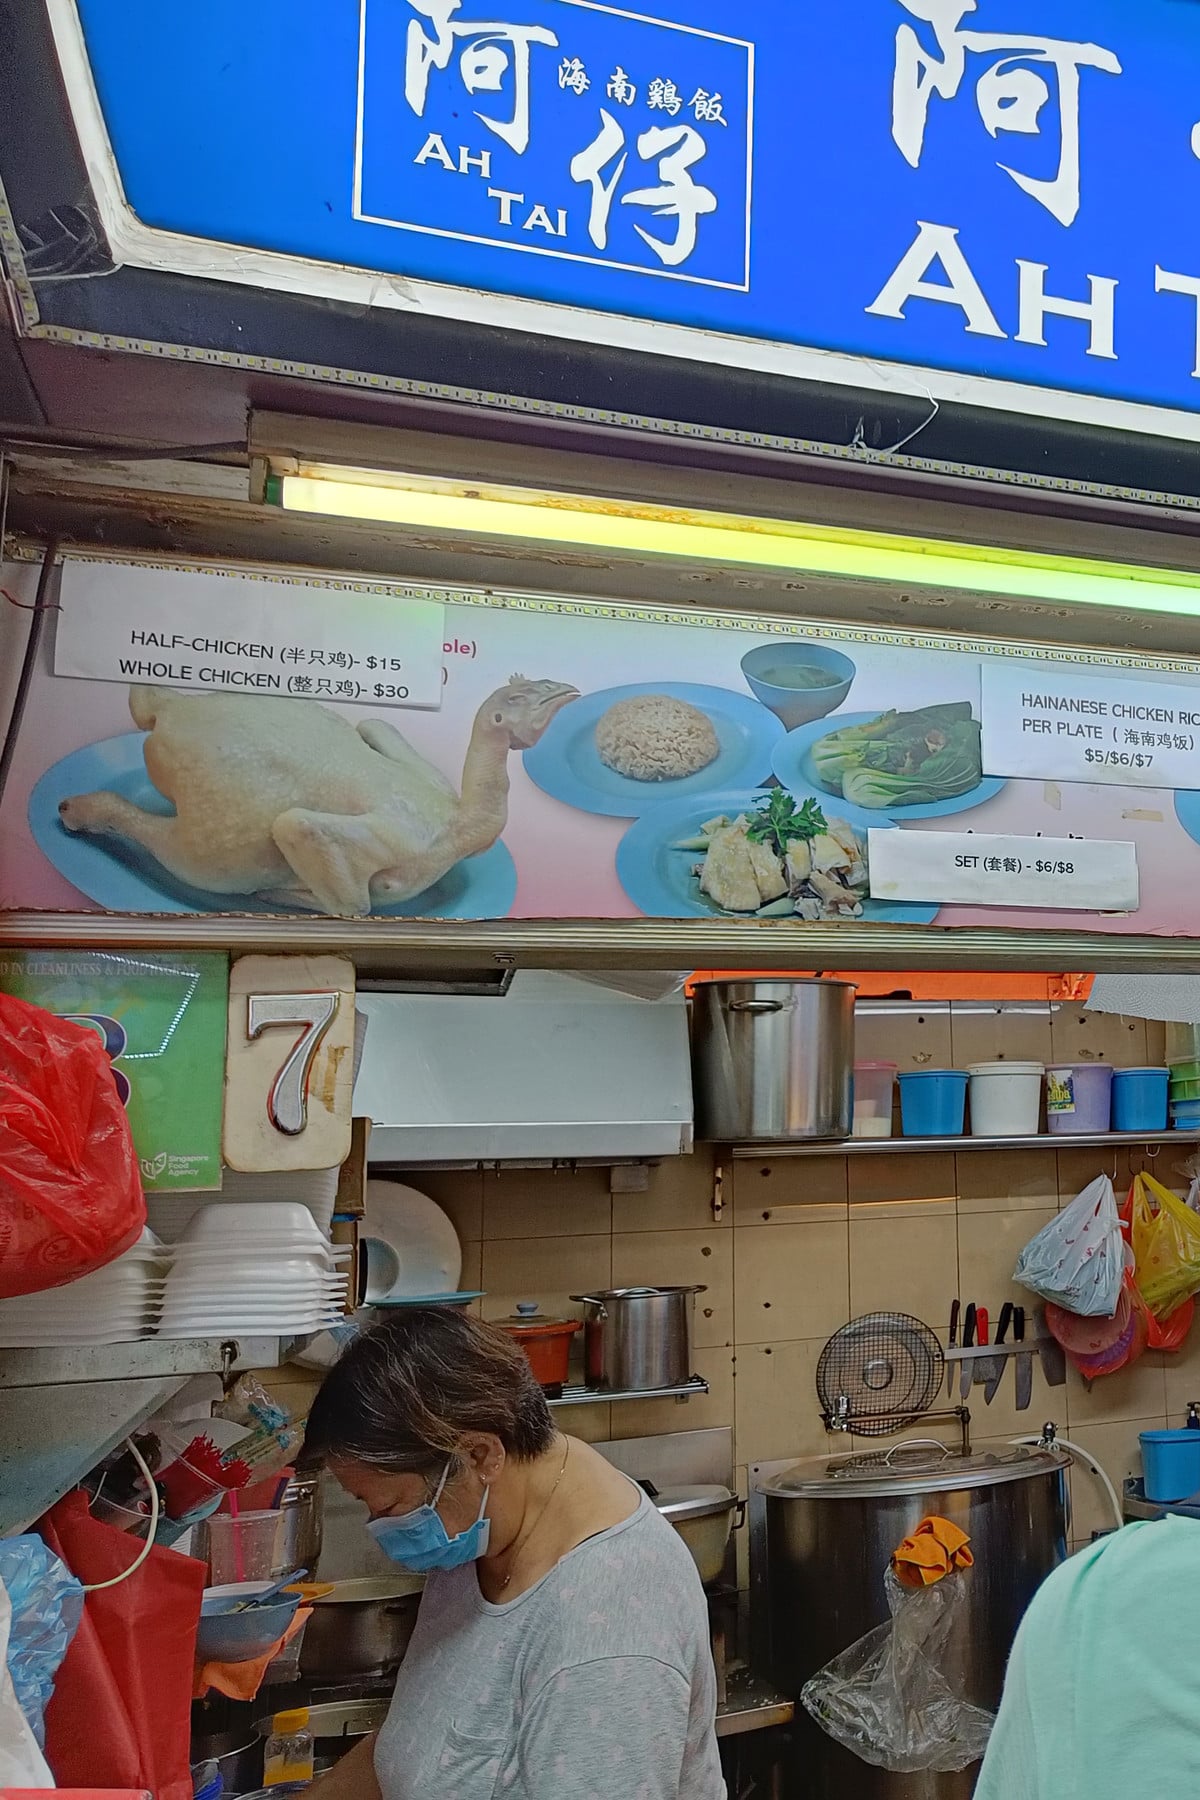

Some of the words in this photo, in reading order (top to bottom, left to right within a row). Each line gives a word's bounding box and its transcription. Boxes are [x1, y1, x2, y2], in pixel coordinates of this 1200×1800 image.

[413, 133, 491, 178] AH
[570, 109, 717, 266] 仔
[487, 187, 568, 237] TAI
[864, 220, 1119, 360] AH
[130, 630, 274, 660] HALF-CHICKEN
[366, 655, 402, 671] $15
[119, 659, 192, 681] WHOLE
[199, 667, 281, 688] CHICKEN
[373, 683, 410, 699] $30
[1021, 693, 1107, 717] HAINANESE
[1112, 703, 1174, 724] CHICKEN
[1022, 718, 1052, 734] PER
[1057, 723, 1103, 740] PLATE
[1084, 748, 1153, 768] $5/$6/$7
[955, 856, 979, 870] SET
[1035, 860, 1075, 875] $6/$8
[249, 991, 340, 1136] 7
